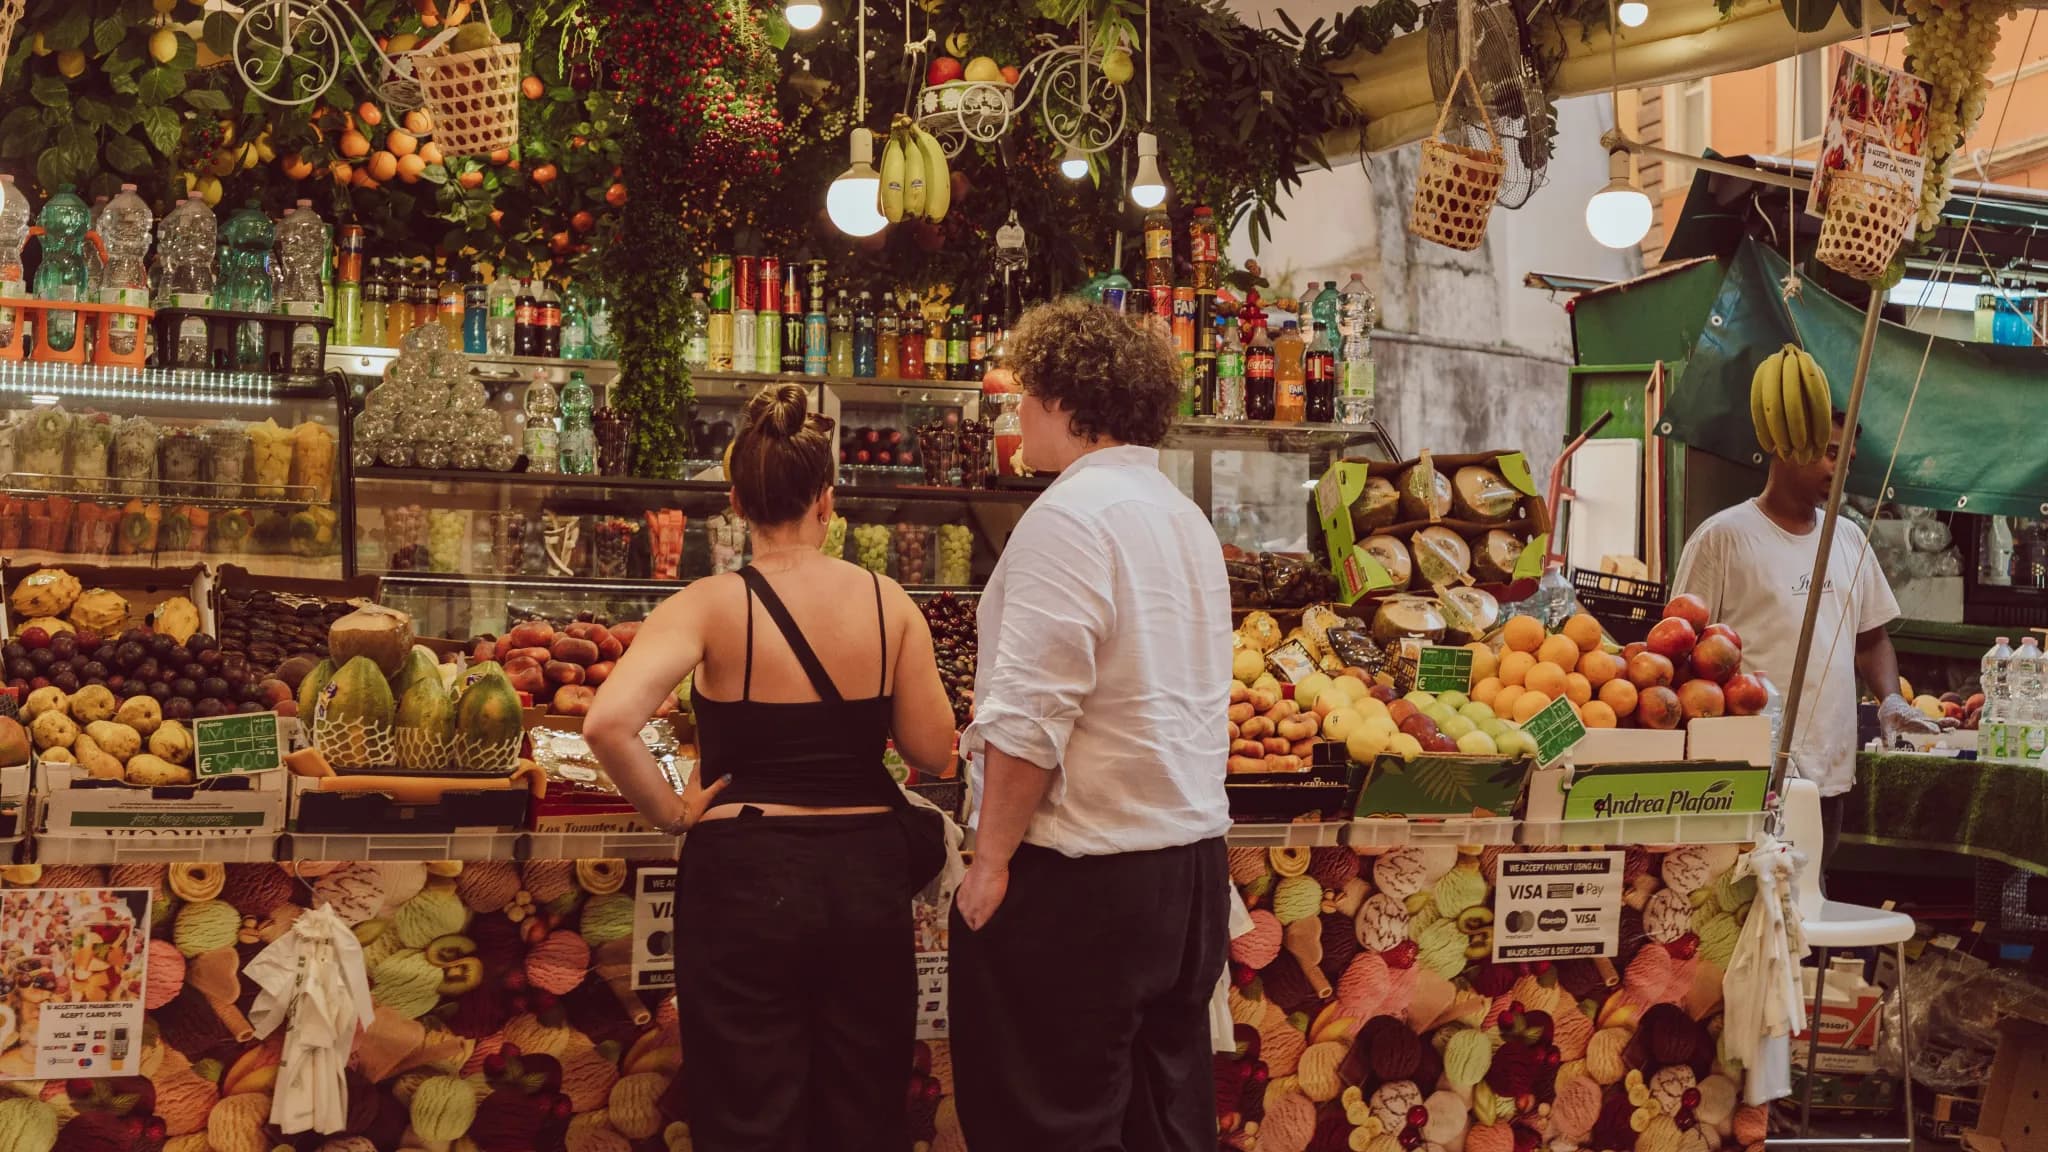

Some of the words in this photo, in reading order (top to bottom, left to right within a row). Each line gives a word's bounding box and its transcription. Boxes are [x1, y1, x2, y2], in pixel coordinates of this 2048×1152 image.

[1873, 160, 1888, 170] ACEPT
[1905, 169, 1915, 177] POS
[1174, 300, 1197, 315] FAN
[201, 757, 213, 773] €
[1593, 792, 1665, 819] Andrea
[1666, 790, 1735, 815] Plafoni
[1509, 864, 1520, 872] WE
[1520, 863, 1544, 872] ACCEPT
[1545, 863, 1572, 871] PAYMENT
[1573, 862, 1592, 871] USING
[1593, 862, 1604, 870] ALL
[1508, 884, 1543, 900] VISA
[1586, 882, 1604, 898] Pay
[648, 901, 674, 919] VI
[1575, 913, 1597, 924] VISA
[1575, 945, 1597, 954] CARDS
